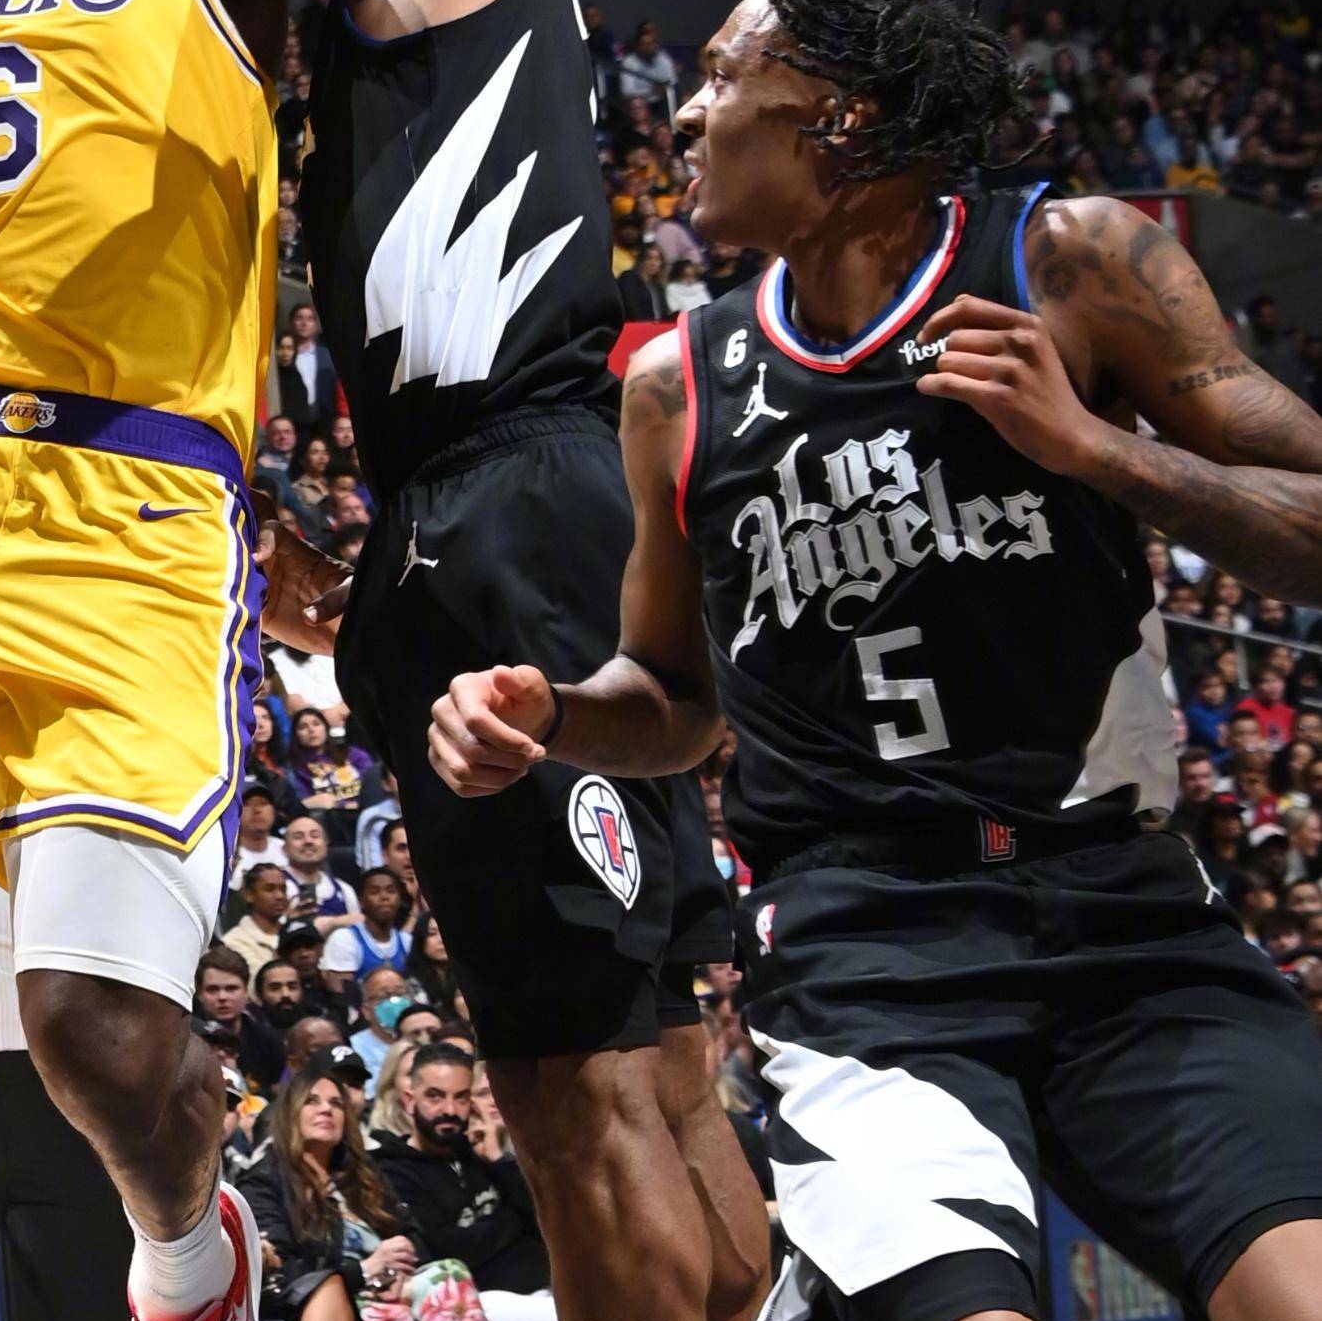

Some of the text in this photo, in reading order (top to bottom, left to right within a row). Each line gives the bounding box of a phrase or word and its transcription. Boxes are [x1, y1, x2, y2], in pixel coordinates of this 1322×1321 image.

[723, 328, 748, 368] 6
[772, 428, 921, 535] Los
[730, 458, 1055, 665] Angeles
[853, 625, 951, 761] 5
